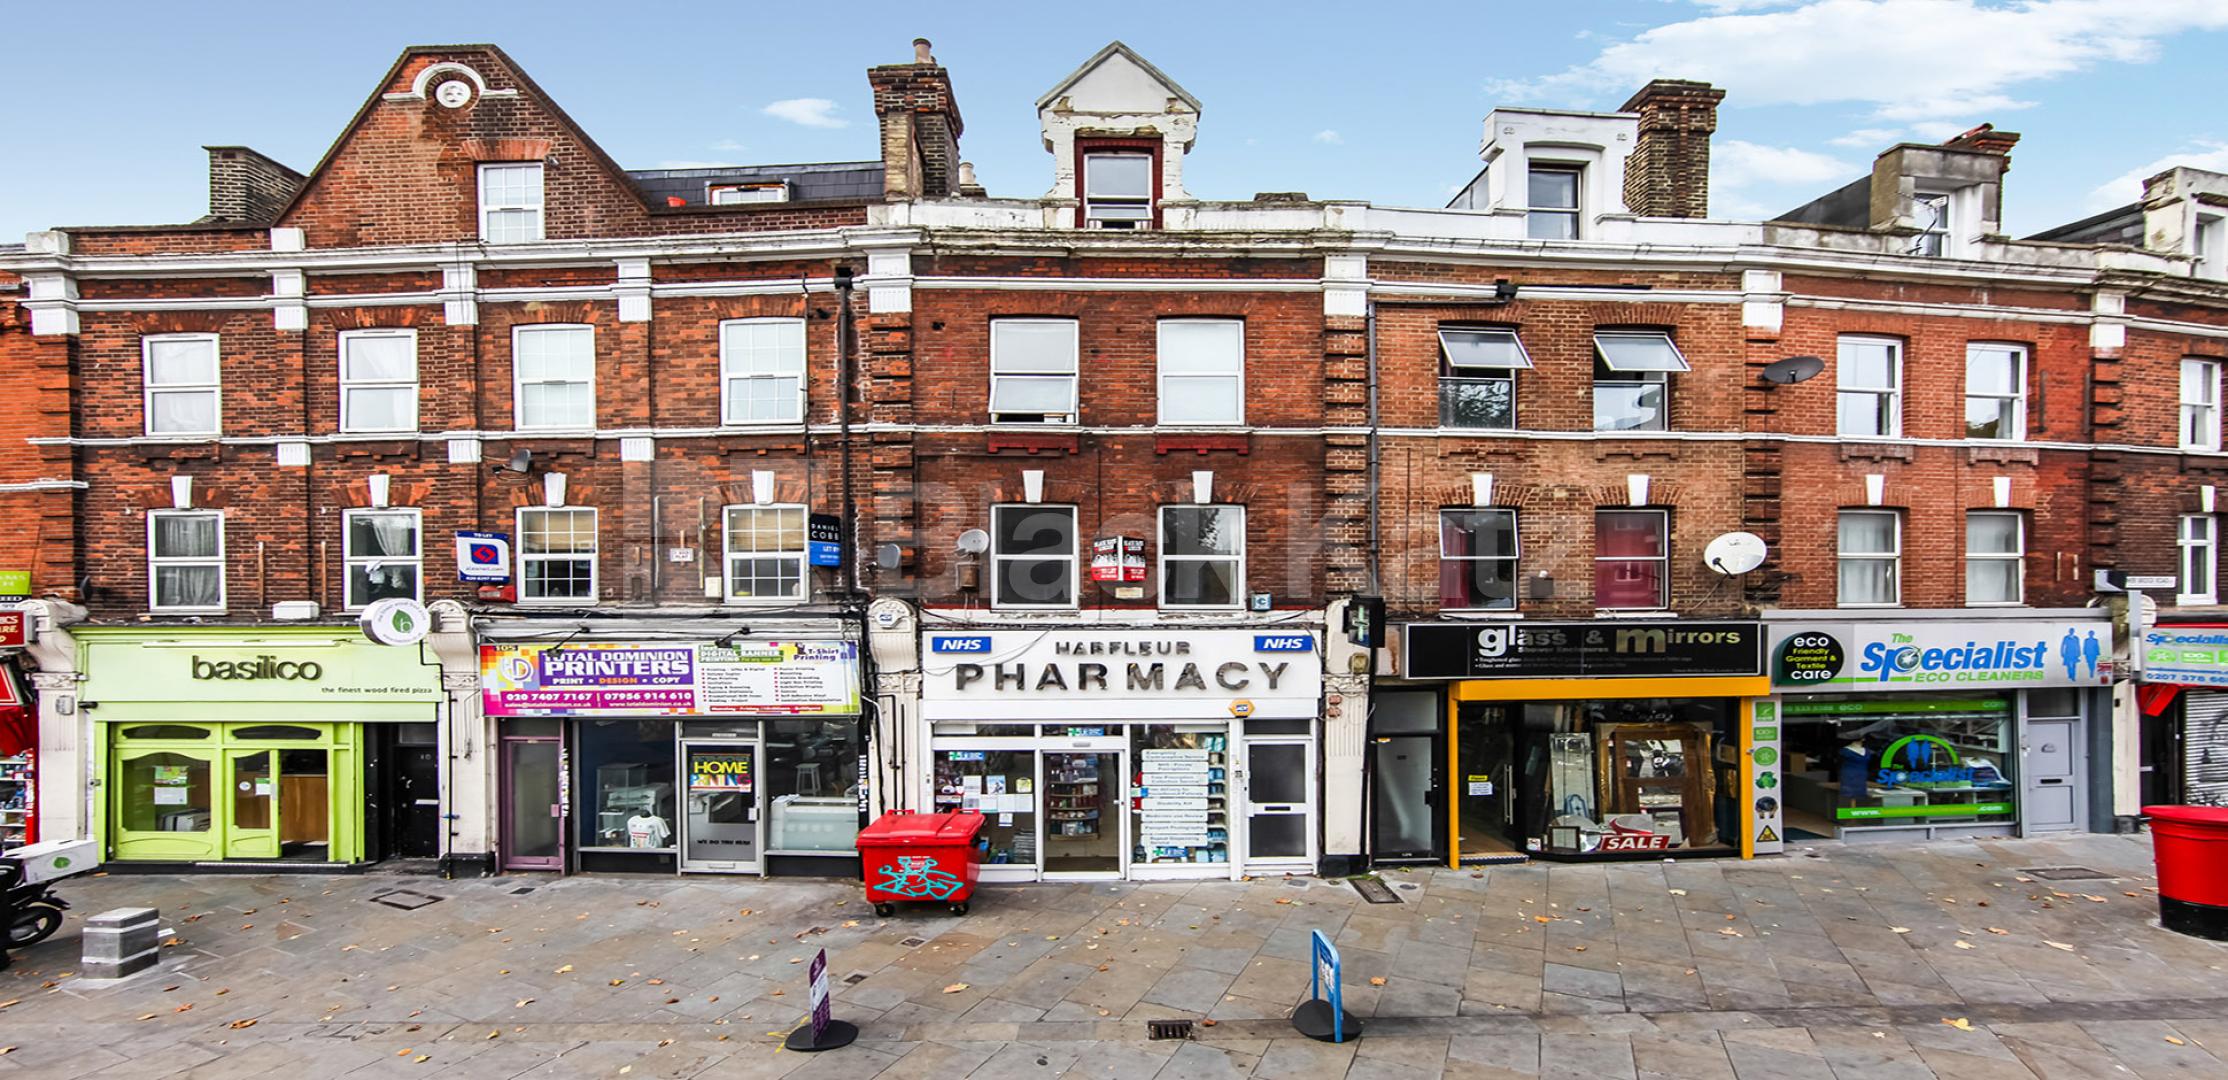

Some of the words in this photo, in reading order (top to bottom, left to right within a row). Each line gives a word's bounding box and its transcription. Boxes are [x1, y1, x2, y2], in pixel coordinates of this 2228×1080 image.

[1477, 625, 1568, 657] glass
[1586, 629, 1604, 645] &
[1793, 637, 1829, 647] eco
[1892, 632, 1914, 643] The
[941, 639, 982, 651] NHS
[1055, 640, 1191, 656] HARFLEUR
[1262, 638, 1304, 650] NHS
[600, 651, 689, 661] DOMINION
[793, 654, 836, 662] Printing
[1860, 641, 2048, 682] Specialist
[191, 654, 323, 681] basilico
[544, 660, 690, 676] PRINTERS
[598, 677, 639, 685] DESIGN
[652, 676, 681, 684] COPY
[954, 661, 1289, 691] PHARMACY
[1790, 670, 1832, 679] care
[1914, 671, 1951, 683] ECO
[1955, 671, 2045, 682] CLEANERS
[321, 686, 337, 694] the
[338, 686, 362, 694] finest
[364, 686, 388, 694] wood
[390, 686, 411, 694] fired
[412, 686, 433, 695] pizza
[506, 693, 529, 701] 020
[531, 693, 560, 701] 7407
[562, 693, 592, 701] 7167
[643, 692, 666, 700] 914
[669, 692, 692, 700] 610
[693, 761, 748, 774] HOME
[1606, 836, 1663, 850] SALE
